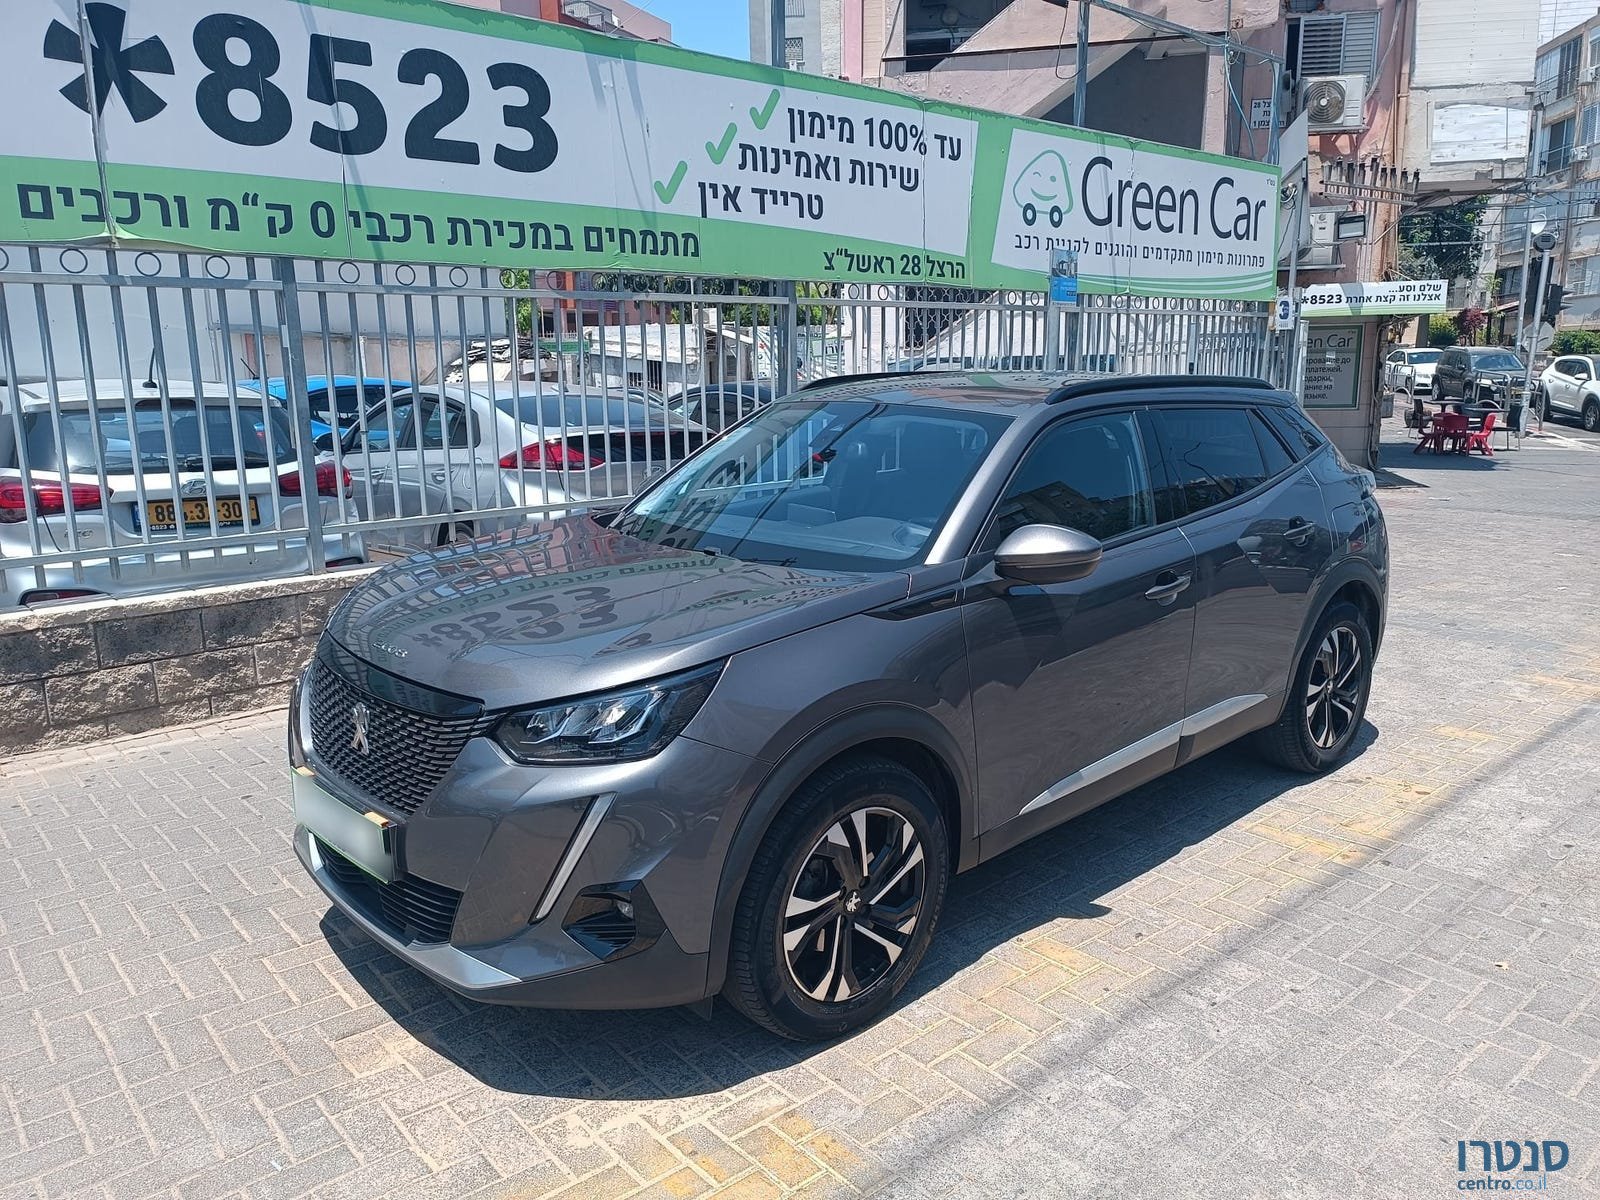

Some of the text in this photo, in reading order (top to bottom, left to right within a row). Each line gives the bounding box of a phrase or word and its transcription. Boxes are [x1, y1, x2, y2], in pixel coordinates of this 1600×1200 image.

[787, 107, 962, 162] עד 100% מימון
[738, 142, 920, 192] שירות ואמינות
[17, 183, 190, 230] ורכבים
[698, 181, 825, 221] טרייד אין
[1081, 155, 1267, 241] Green Car
[310, 200, 336, 238] 0
[350, 209, 436, 245] רכבי
[447, 215, 574, 253] במכירת
[586, 223, 700, 258] מתמחים
[1014, 233, 1040, 250] רכב
[1095, 241, 1138, 259] והוגנים
[1142, 245, 1194, 266] מתקדמים
[1196, 248, 1224, 267] מימון
[1226, 252, 1266, 268] פתרונות
[900, 253, 922, 276] 28
[925, 254, 966, 280] הרצל
[1399, 294, 1411, 302] זה
[1413, 292, 1442, 301] אצלנו
[1419, 282, 1442, 292] שלם
[1345, 295, 1373, 304] אחרת
[1375, 294, 1396, 304] קצת
[1326, 334, 1353, 348] Car
